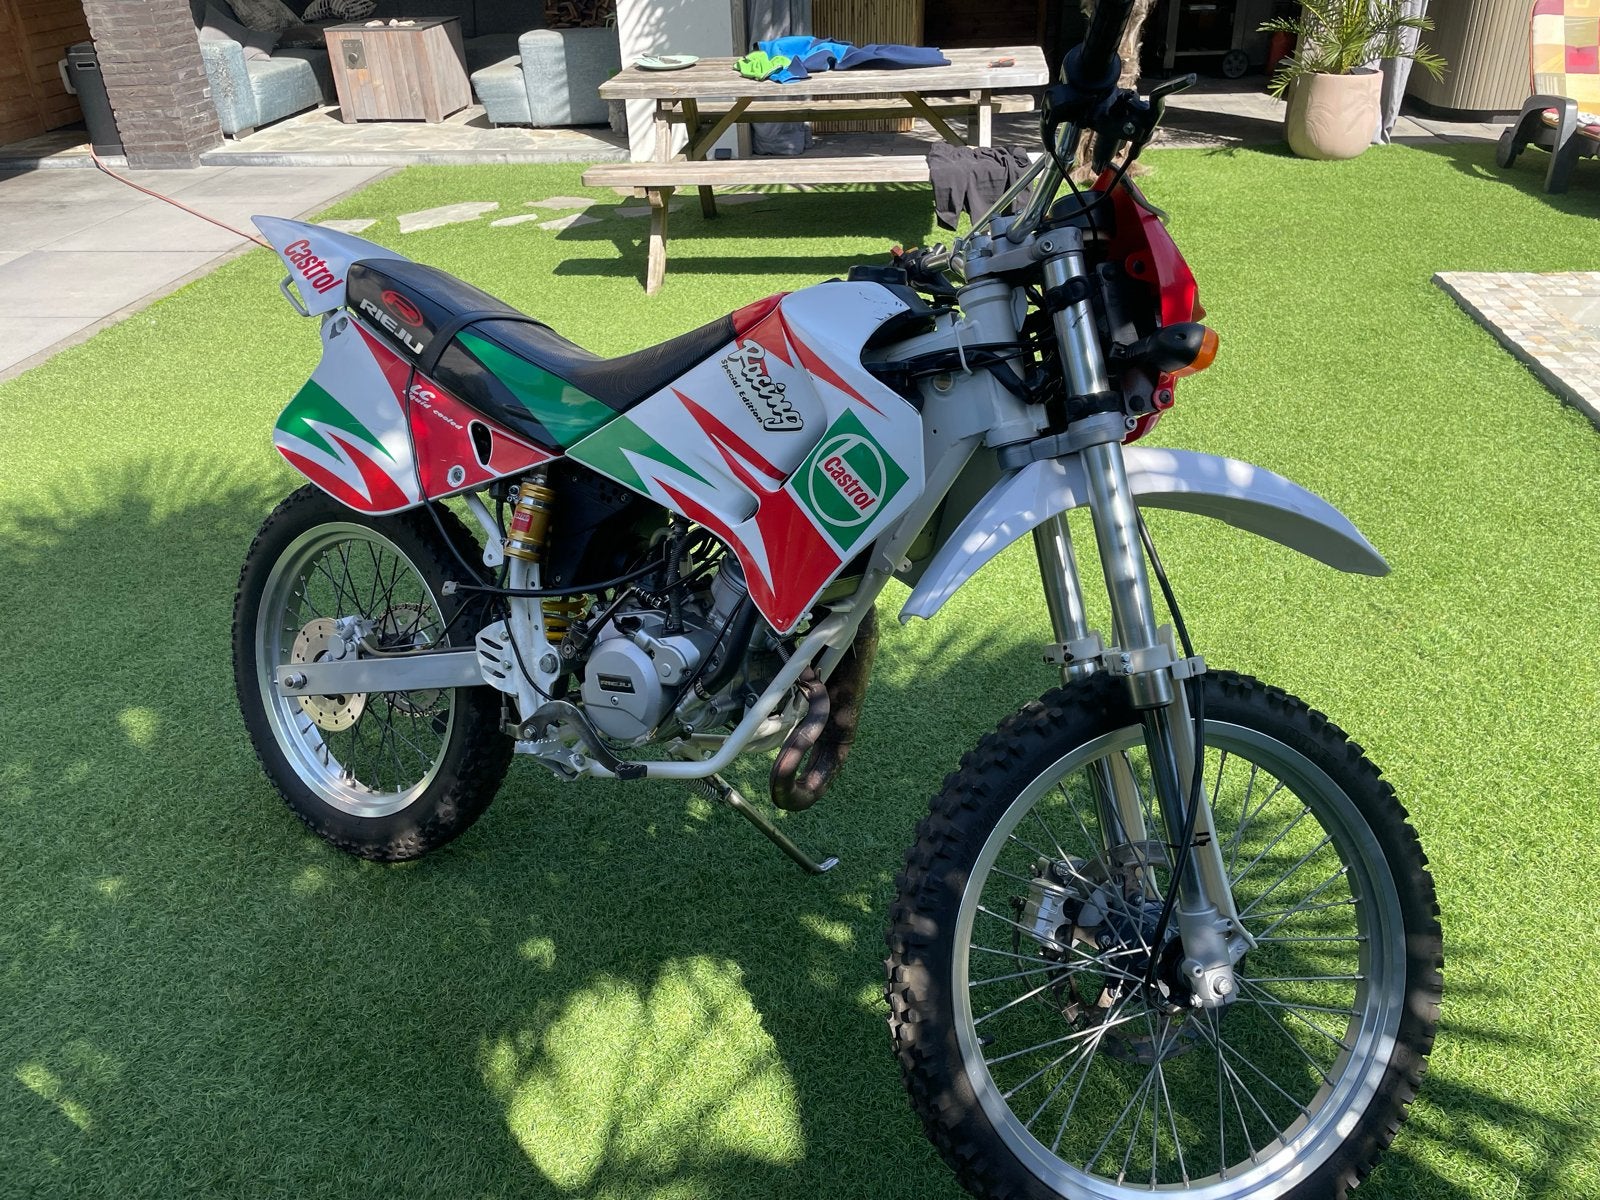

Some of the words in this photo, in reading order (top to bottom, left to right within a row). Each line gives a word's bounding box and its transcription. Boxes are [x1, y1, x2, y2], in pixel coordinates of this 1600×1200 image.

[284, 239, 343, 294] Castrol
[360, 298, 424, 354] RIEJU
[409, 384, 436, 402] LC
[721, 359, 741, 389] Special
[739, 391, 763, 423] Edition
[727, 338, 804, 431] Racing
[433, 410, 463, 429] cooled
[823, 456, 876, 511] Castrol
